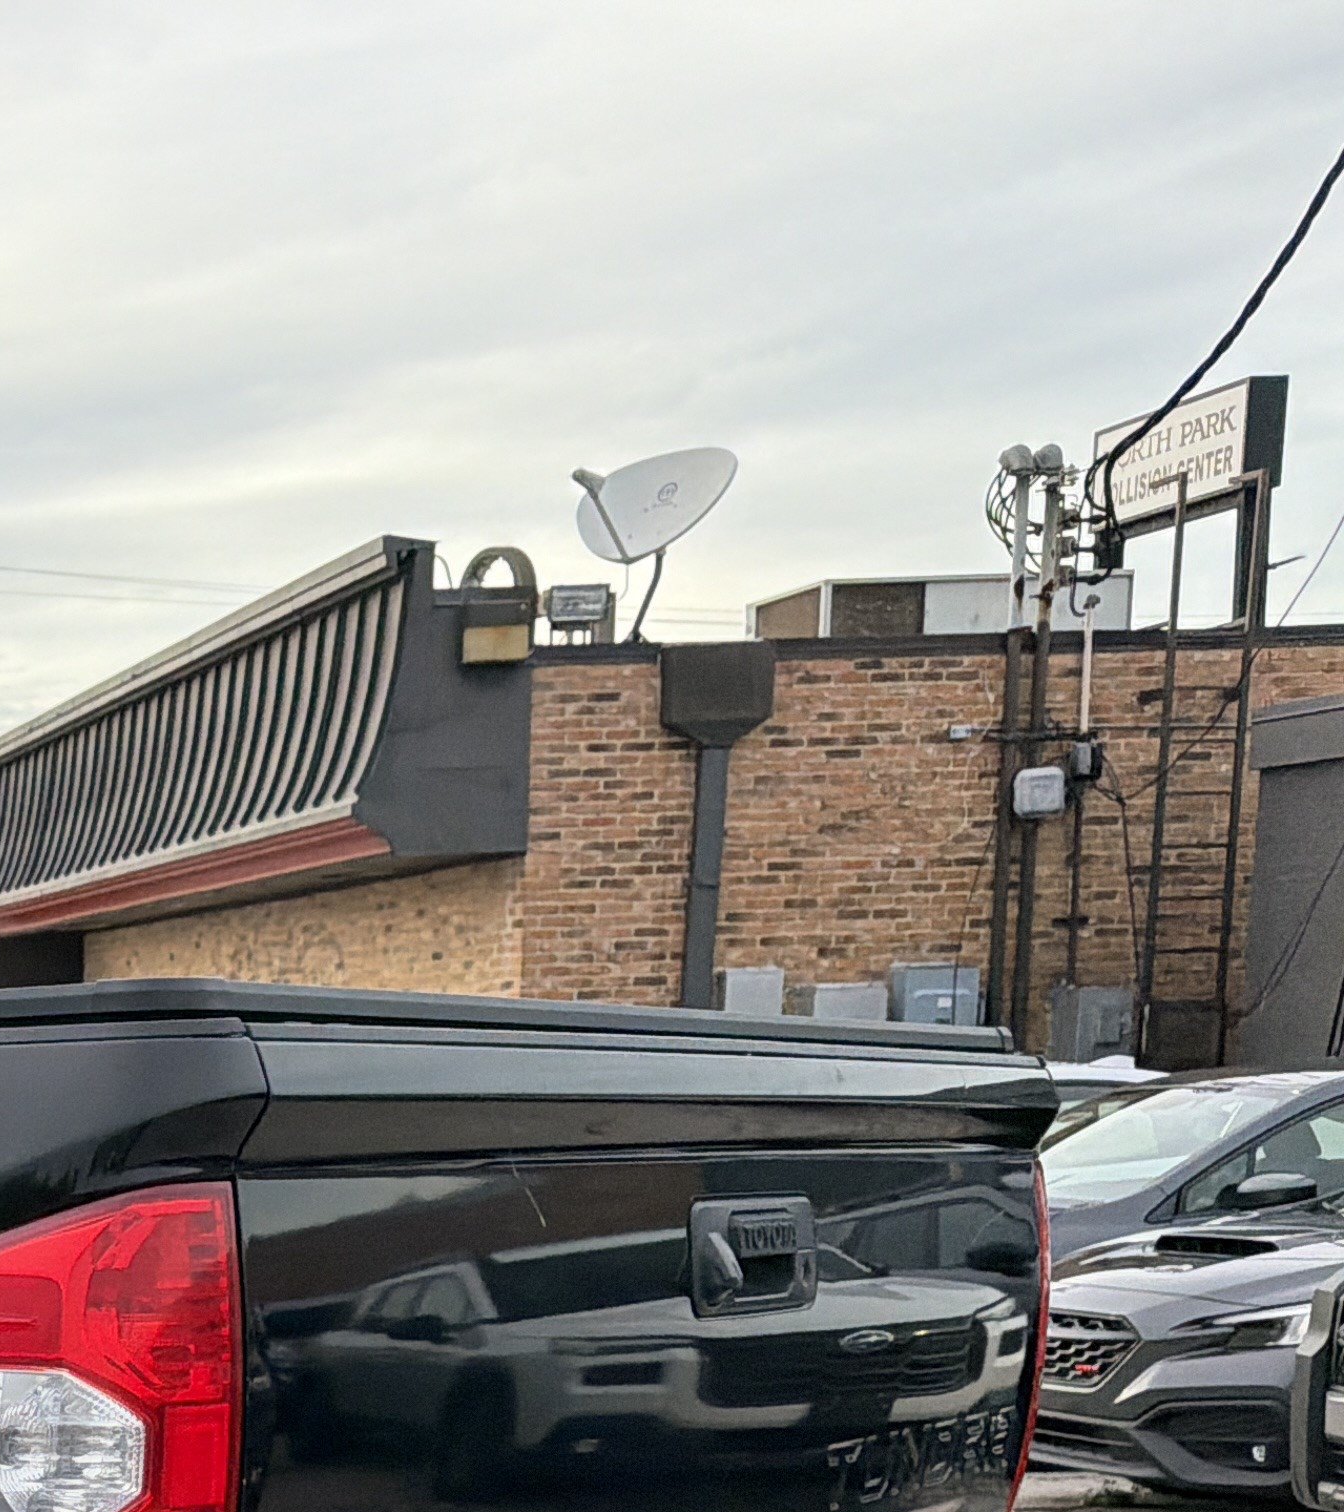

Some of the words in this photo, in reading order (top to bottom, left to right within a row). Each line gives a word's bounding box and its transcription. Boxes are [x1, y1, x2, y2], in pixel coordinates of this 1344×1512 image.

[1107, 427, 1172, 470] ORTH
[1179, 405, 1237, 448] PARK
[1103, 462, 1172, 506] OLLISION
